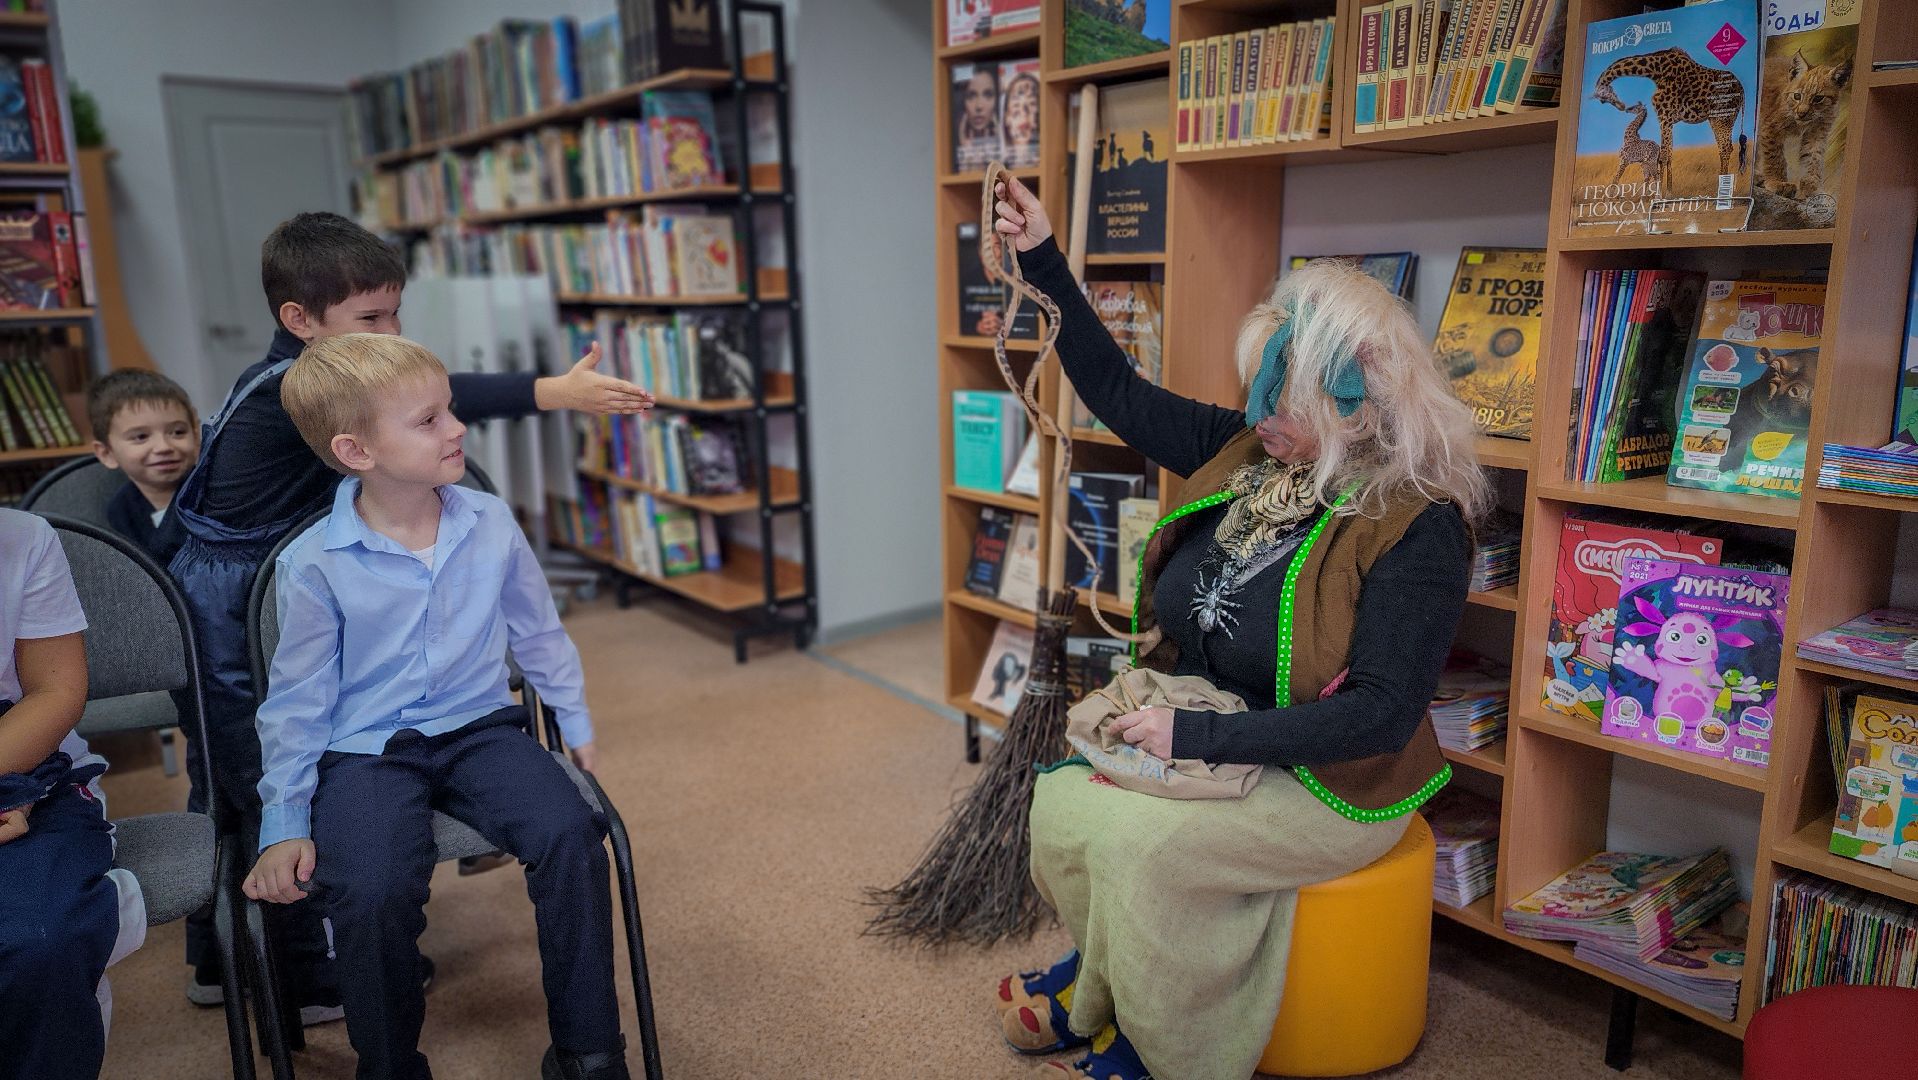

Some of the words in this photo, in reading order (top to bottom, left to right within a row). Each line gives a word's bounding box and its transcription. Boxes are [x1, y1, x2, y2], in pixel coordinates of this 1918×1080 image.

[1398, 8, 1408, 47] ТОЛСТОЙ
[1423, 1, 1434, 38] УАЙЛЬД
[1447, 0, 1461, 38] ФРОММ
[1367, 15, 1377, 47] СТОКЕР
[1592, 34, 1625, 55] ВОКРУГ
[1642, 21, 1672, 36] СВЕТА
[1722, 28, 1731, 42] 9
[1366, 49, 1375, 71] БРЭМ
[1420, 39, 1429, 62] ОСКАР
[1248, 38, 1261, 90] ПЛАТОН
[1581, 180, 1661, 200] ТЕОРИЯ
[1107, 228, 1139, 238] РОССИИ
[1456, 277, 1473, 294] В
[1616, 433, 1670, 453] ЛАБРАДОР
[1630, 571, 1649, 580] 2021
[1672, 575, 1773, 606] ЛУНТИК
